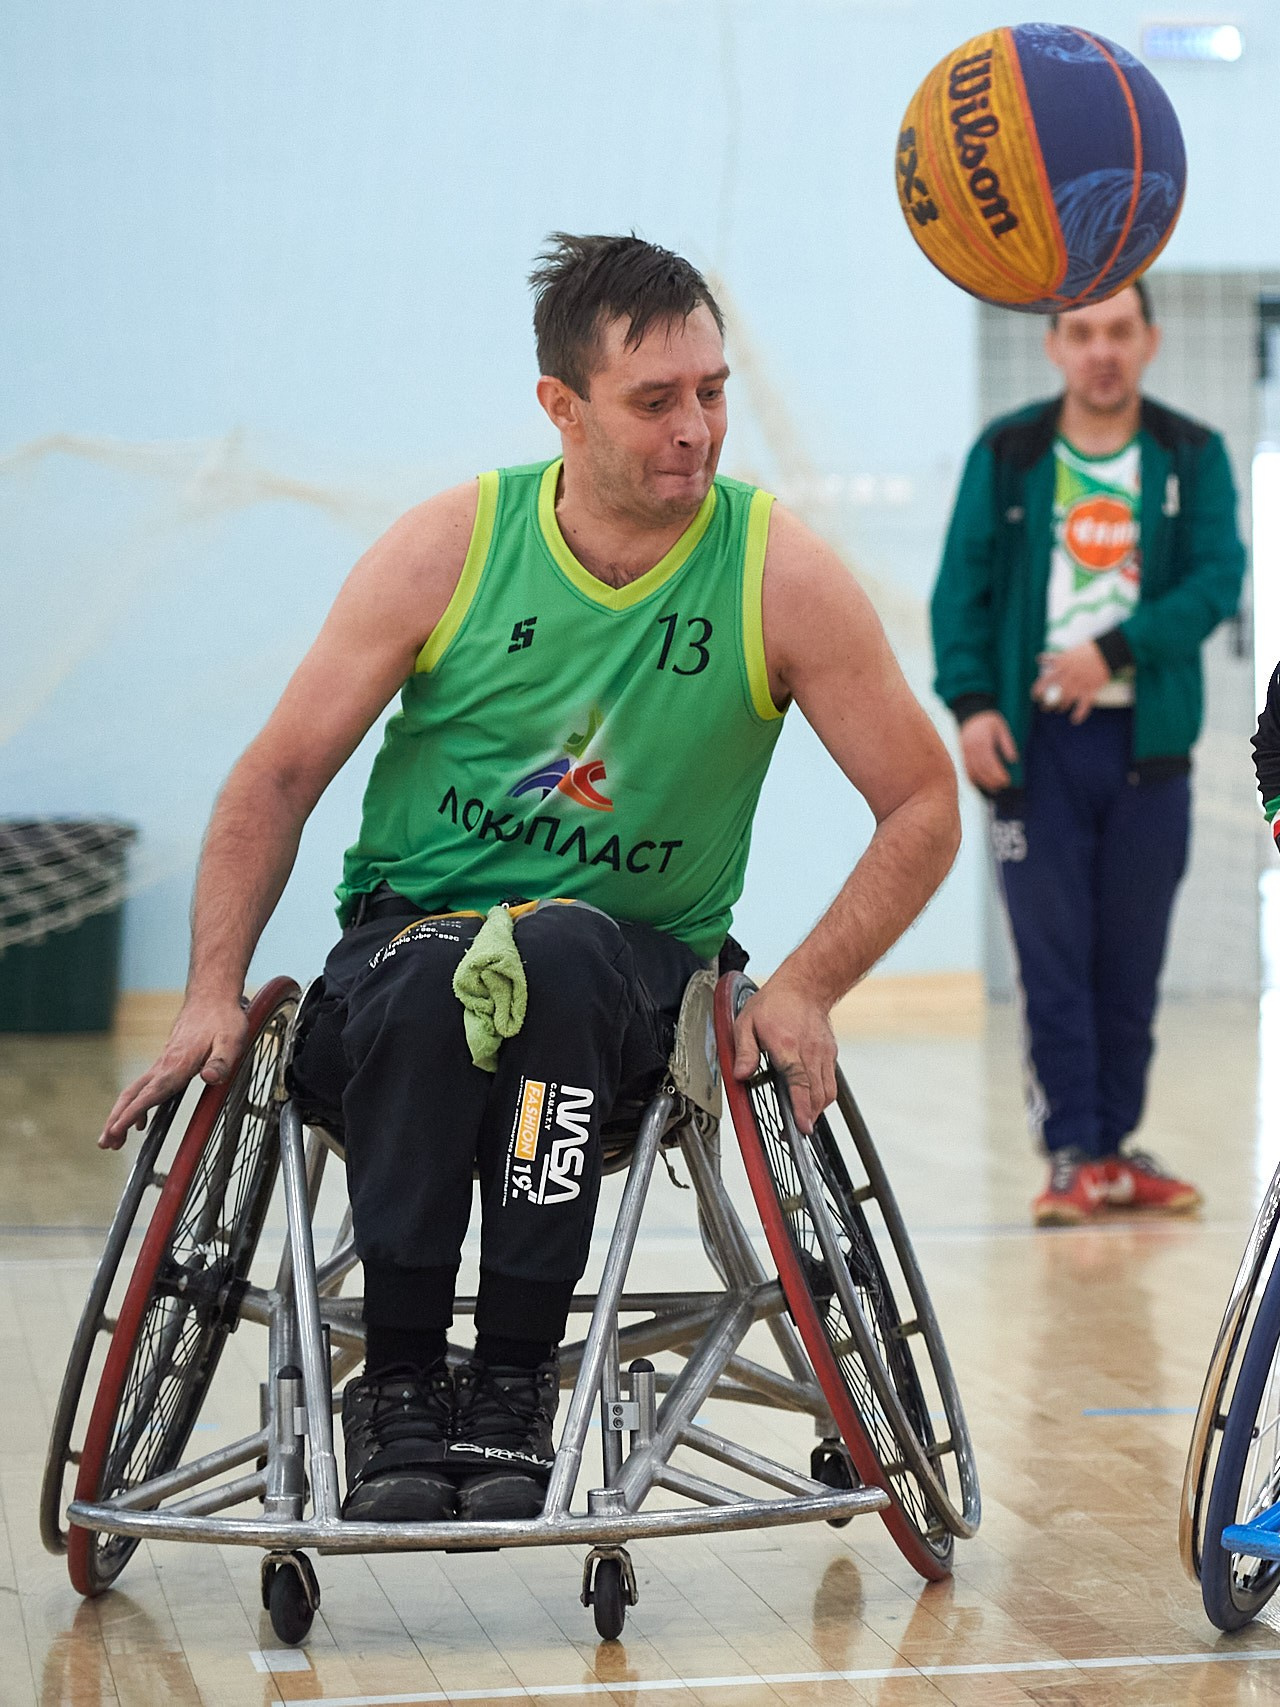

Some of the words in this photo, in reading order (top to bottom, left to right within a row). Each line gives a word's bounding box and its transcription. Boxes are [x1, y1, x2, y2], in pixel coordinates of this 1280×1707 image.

[949, 49, 1019, 239] Wilson
[655, 612, 714, 676] 13
[520, 1085, 542, 1158] FASHION
[543, 1085, 595, 1205] NASA
